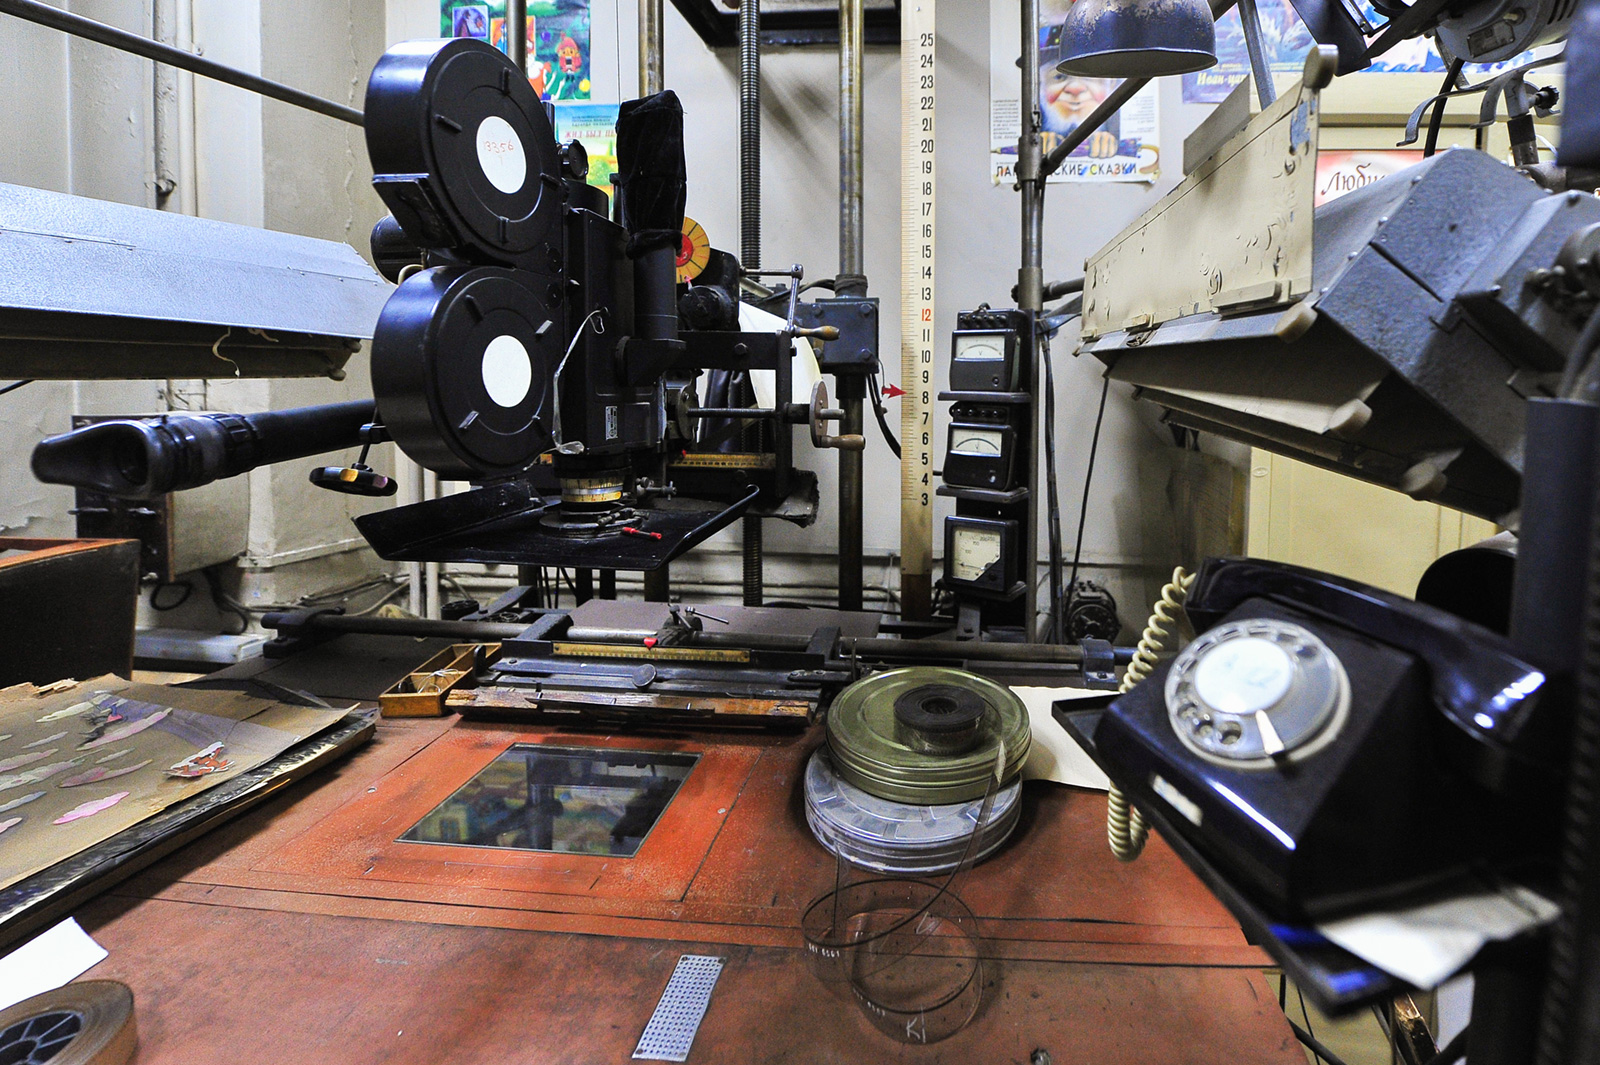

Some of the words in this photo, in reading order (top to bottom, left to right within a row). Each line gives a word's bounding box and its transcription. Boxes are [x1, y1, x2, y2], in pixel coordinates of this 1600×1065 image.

[920, 33, 934, 47] 25
[920, 54, 934, 68] 24
[920, 74, 934, 89] 23
[920, 96, 934, 110] 22
[922, 117, 932, 132] 21
[921, 139, 934, 154] 20
[922, 160, 932, 174] 19
[1090, 162, 1137, 175] СКАЗКИ
[922, 181, 932, 196] 18
[922, 202, 932, 216] 17
[922, 224, 932, 238] 16
[922, 244, 932, 259] 15
[922, 266, 932, 279] 14
[921, 287, 932, 301] 13
[921, 308, 932, 322] 12
[922, 328, 930, 342] 11
[921, 349, 931, 364] 10
[922, 370, 929, 384] 9
[922, 390, 929, 405] 8
[921, 411, 929, 425] 7
[922, 431, 929, 446] 6
[921, 452, 929, 466] 5
[921, 472, 929, 486] 4
[921, 492, 929, 507] 3
